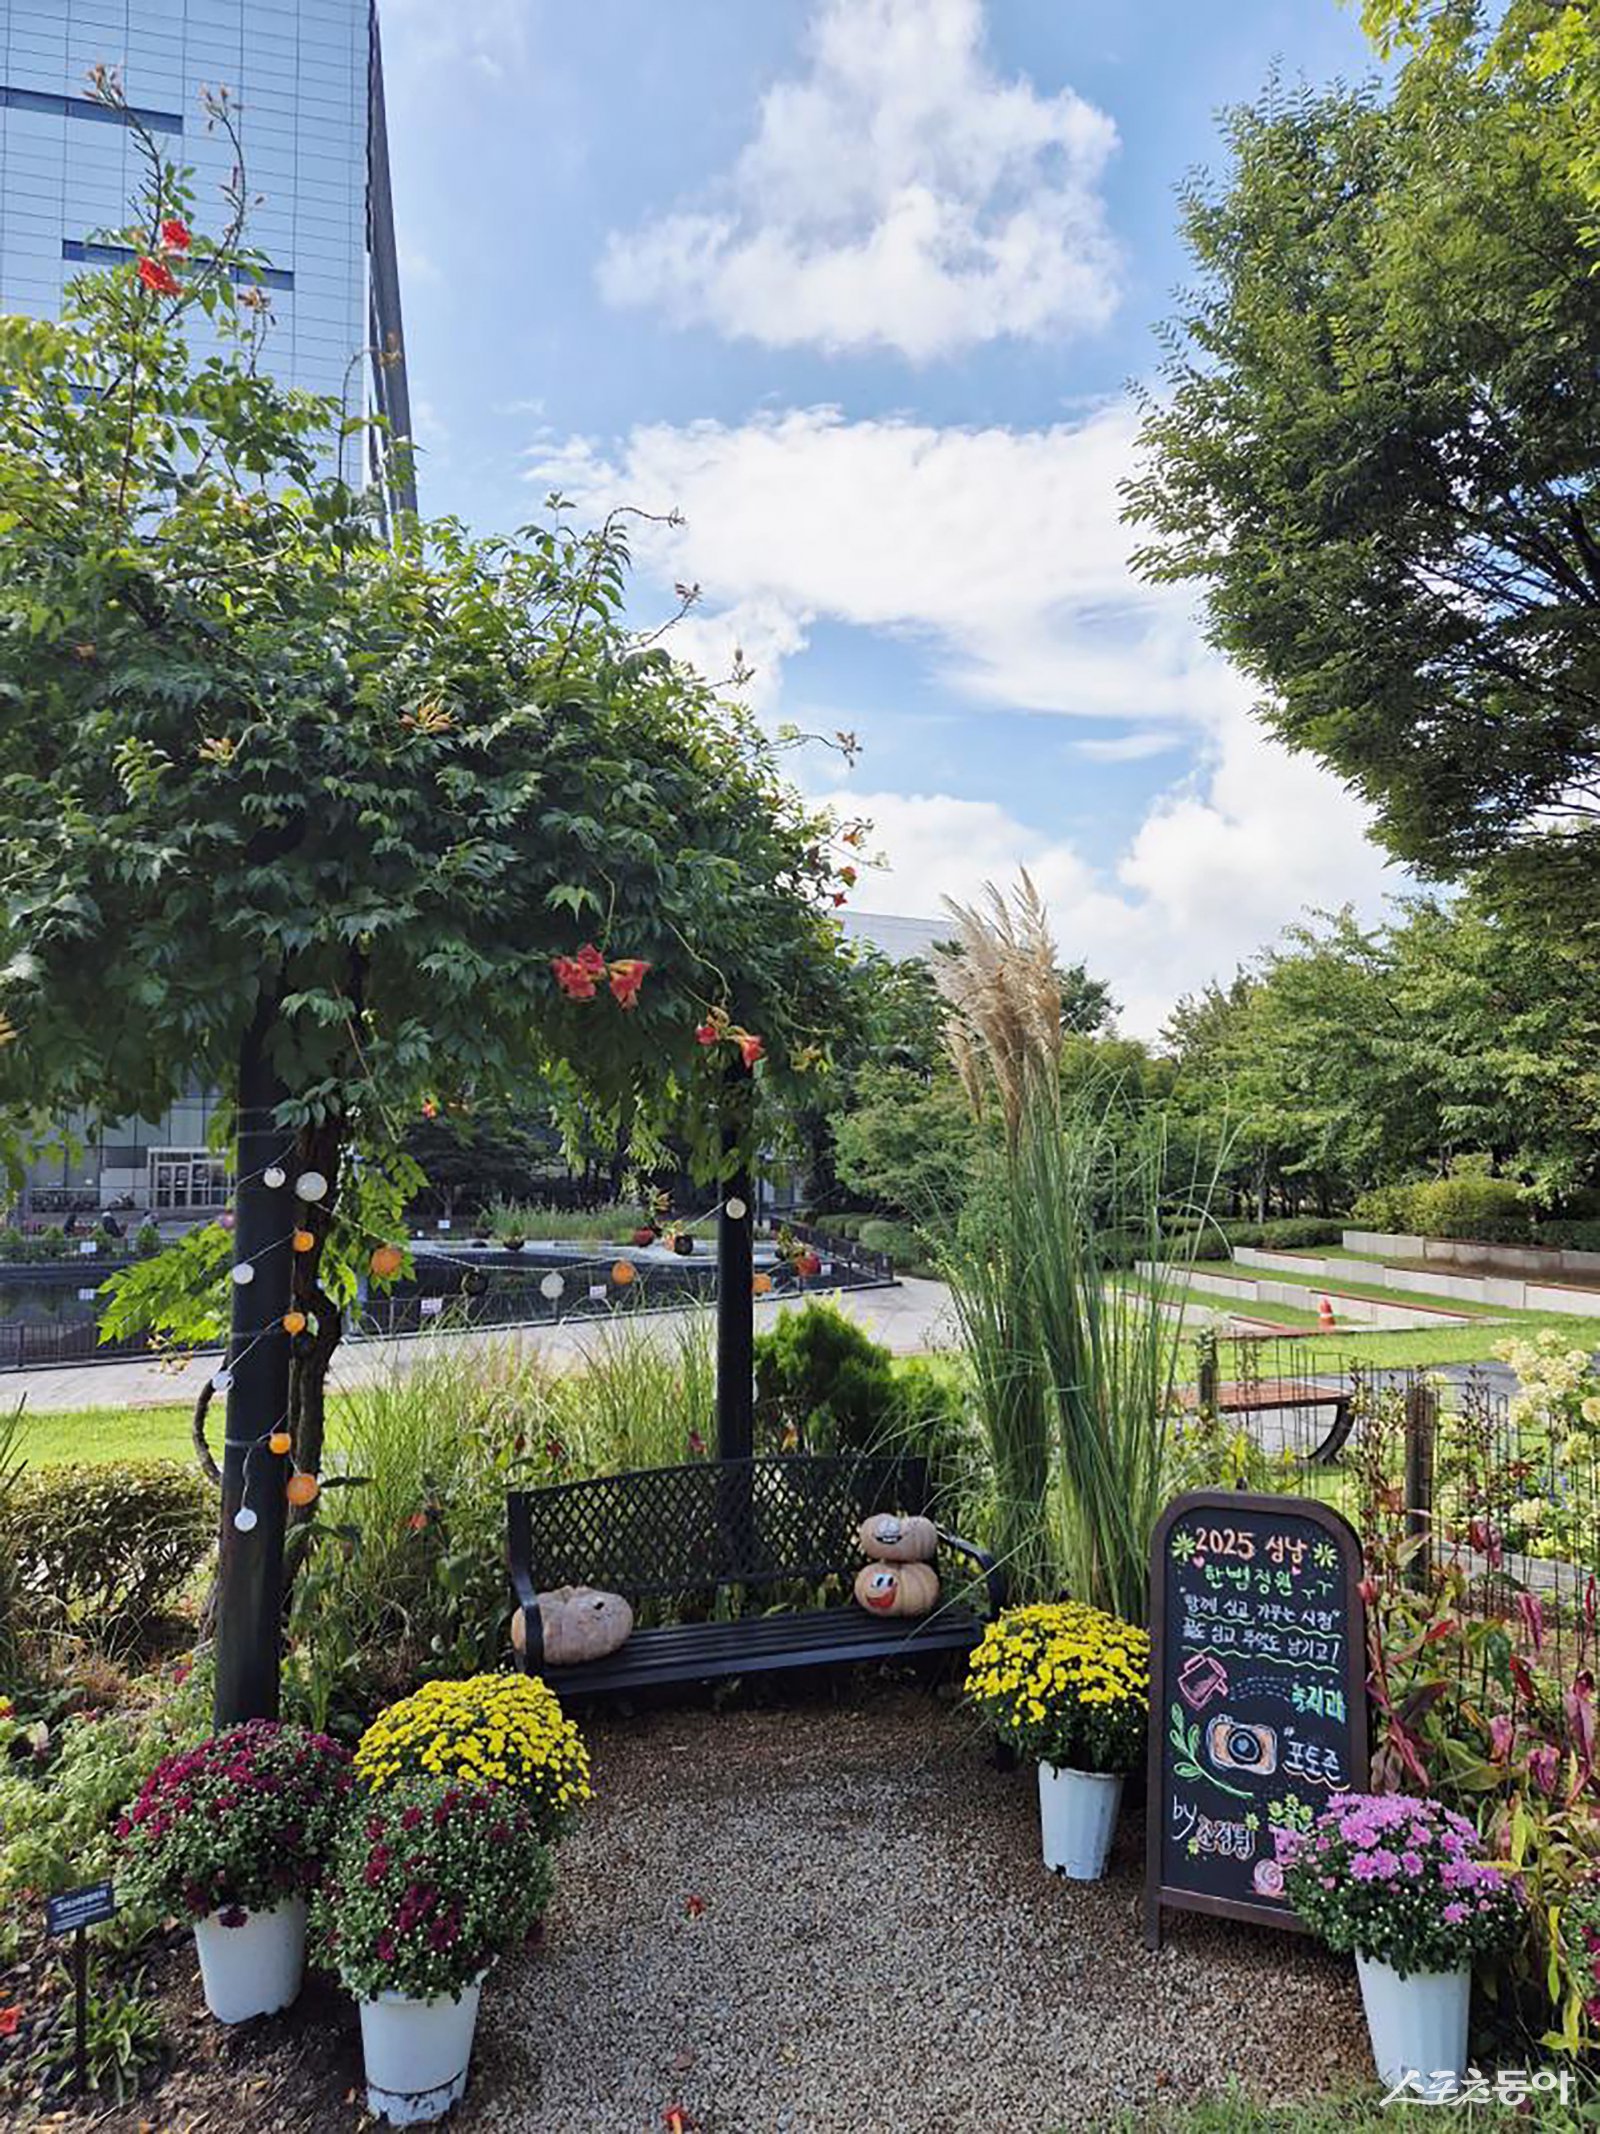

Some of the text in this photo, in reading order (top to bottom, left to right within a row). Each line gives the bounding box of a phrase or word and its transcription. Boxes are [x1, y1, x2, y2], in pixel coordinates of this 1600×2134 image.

[1196, 1528, 1308, 1563] 2025 성남
[1223, 1600, 1249, 1618] 심고
[1211, 1625, 1236, 1643] 심고
[1172, 1794, 1198, 1841] by
